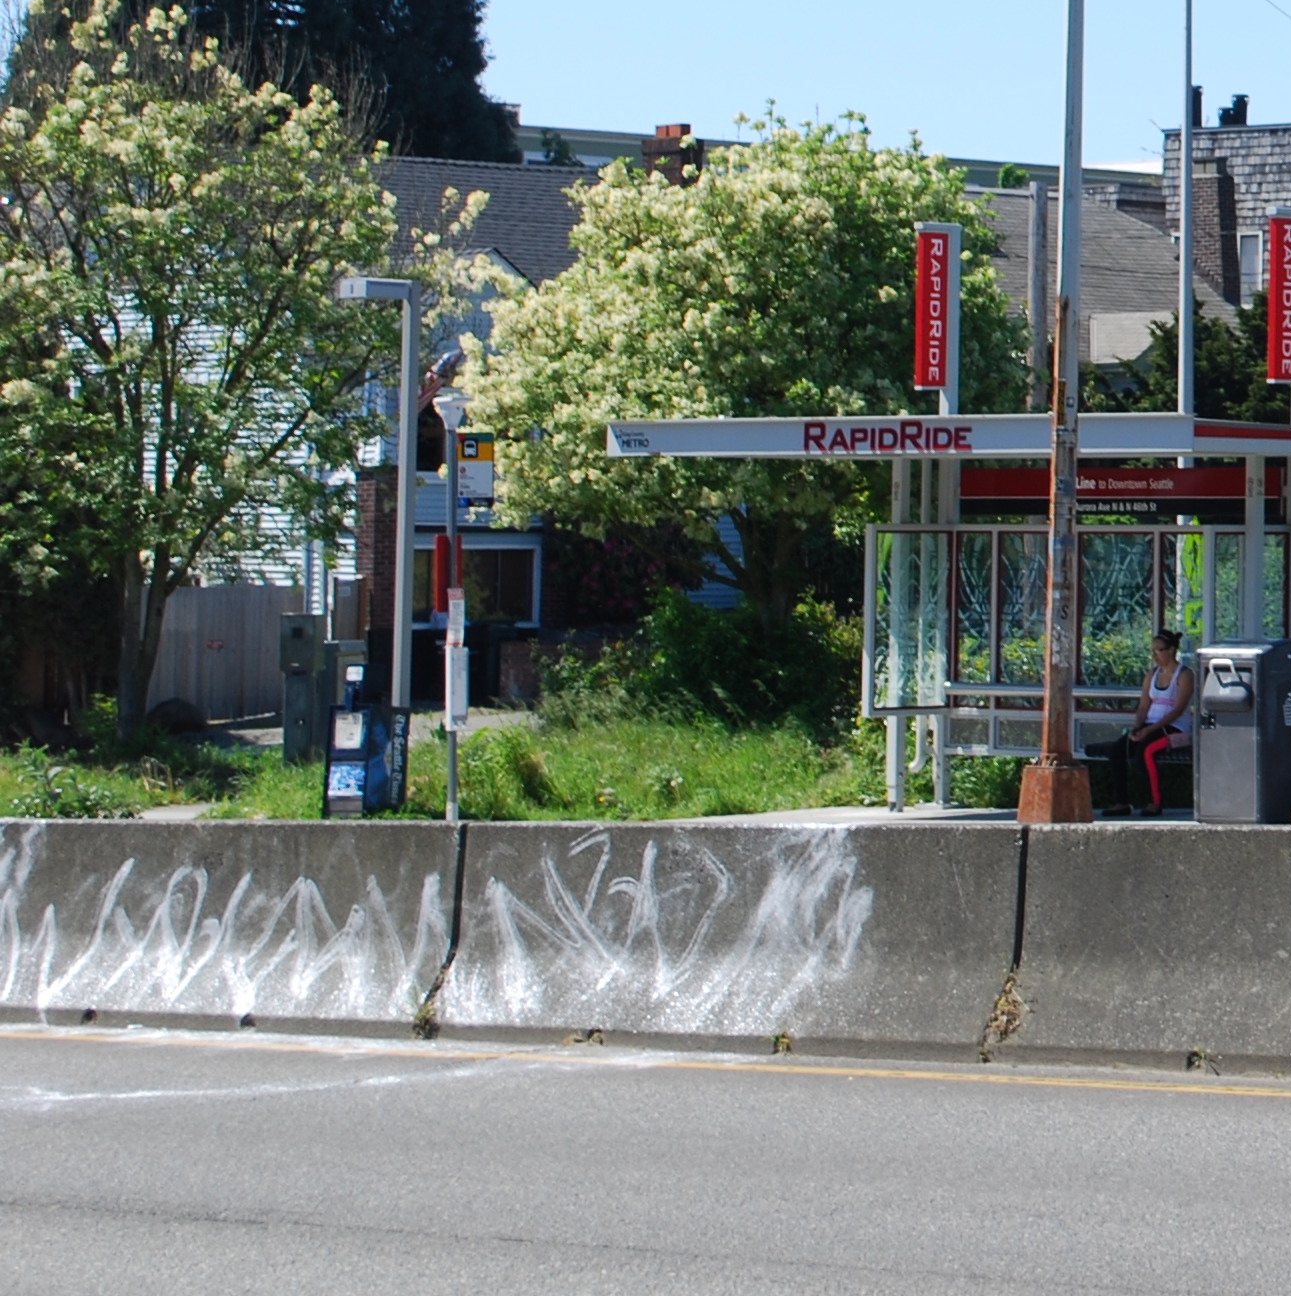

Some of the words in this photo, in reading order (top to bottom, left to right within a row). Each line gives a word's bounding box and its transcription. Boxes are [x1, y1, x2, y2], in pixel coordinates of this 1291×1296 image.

[621, 438, 650, 448] METRO
[1075, 475, 1097, 489] Line
[1098, 480, 1107, 489] to
[1108, 478, 1147, 489] Downtown
[1149, 478, 1174, 489] Seattle
[1098, 502, 1111, 511] Ave
[1112, 503, 1118, 511] N
[1150, 502, 1157, 511] St
[394, 736, 405, 772] Seattle
